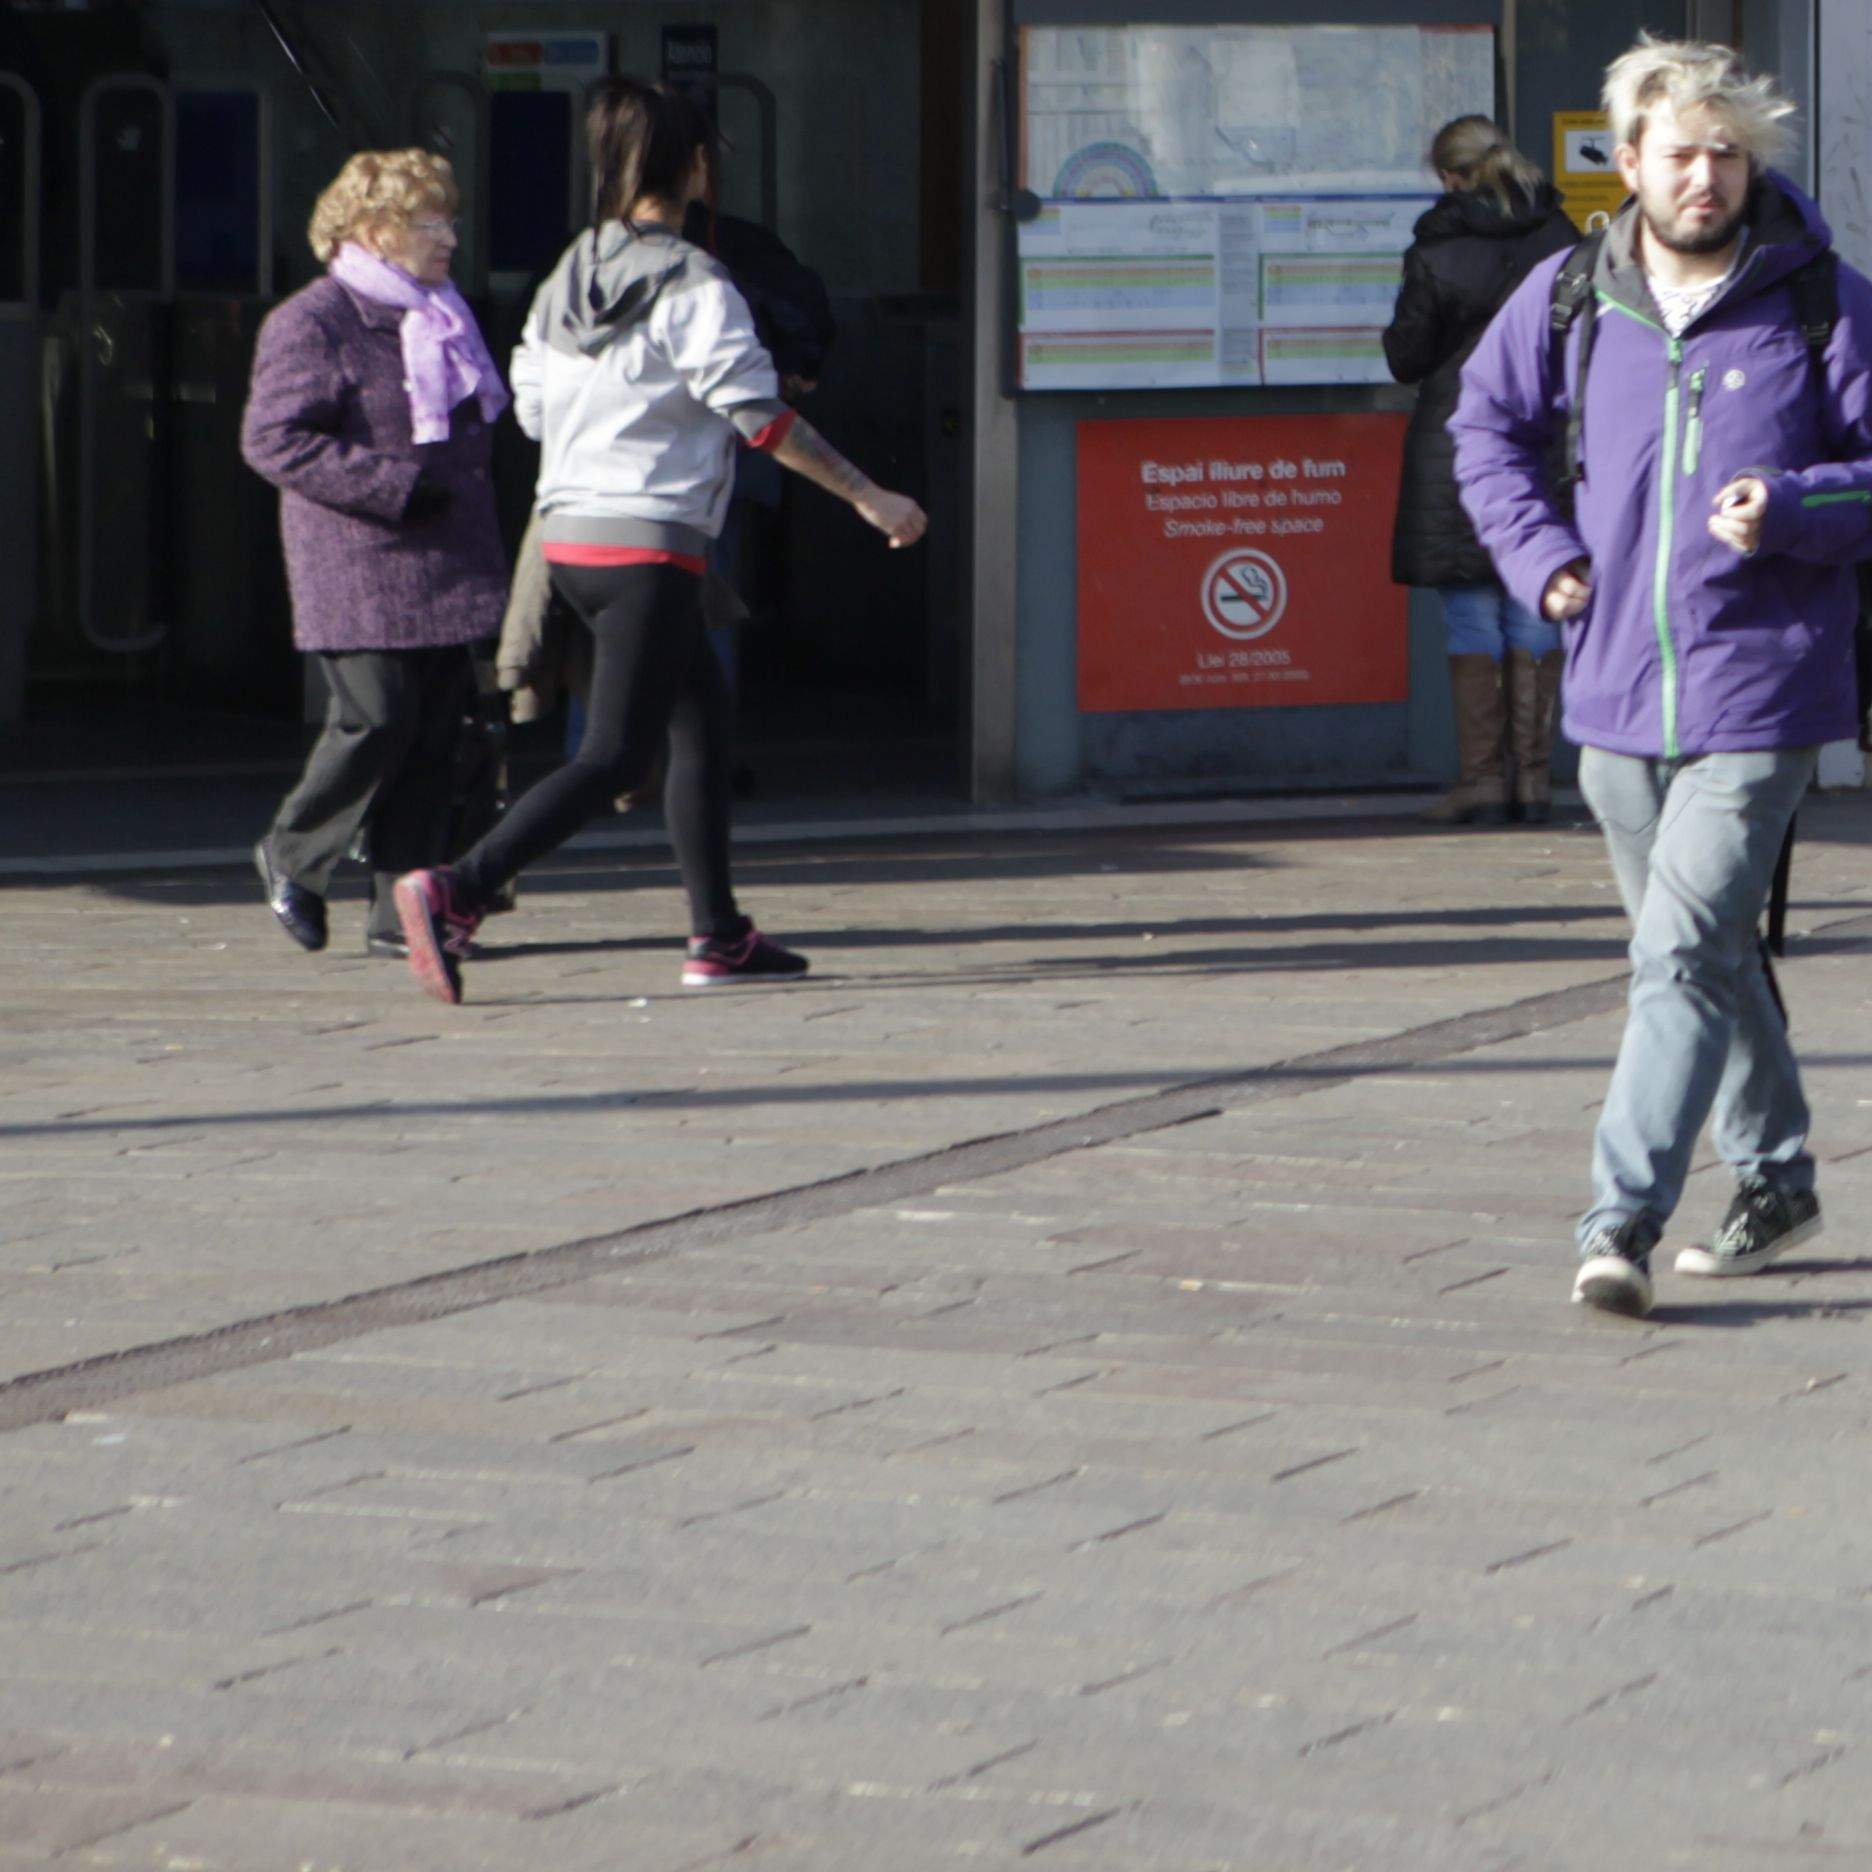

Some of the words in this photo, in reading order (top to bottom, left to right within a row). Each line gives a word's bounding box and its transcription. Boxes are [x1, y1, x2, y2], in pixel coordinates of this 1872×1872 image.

[1140, 461, 1204, 486] Espai
[1209, 459, 1264, 481] lliure
[1268, 459, 1298, 479] de
[1303, 456, 1347, 478] fum
[1145, 492, 1219, 513] Espacio
[1221, 490, 1260, 508] libre
[1263, 489, 1288, 507] de
[1291, 488, 1343, 507] humo
[1163, 516, 1267, 538] Smoke-free
[1271, 517, 1325, 536] space
